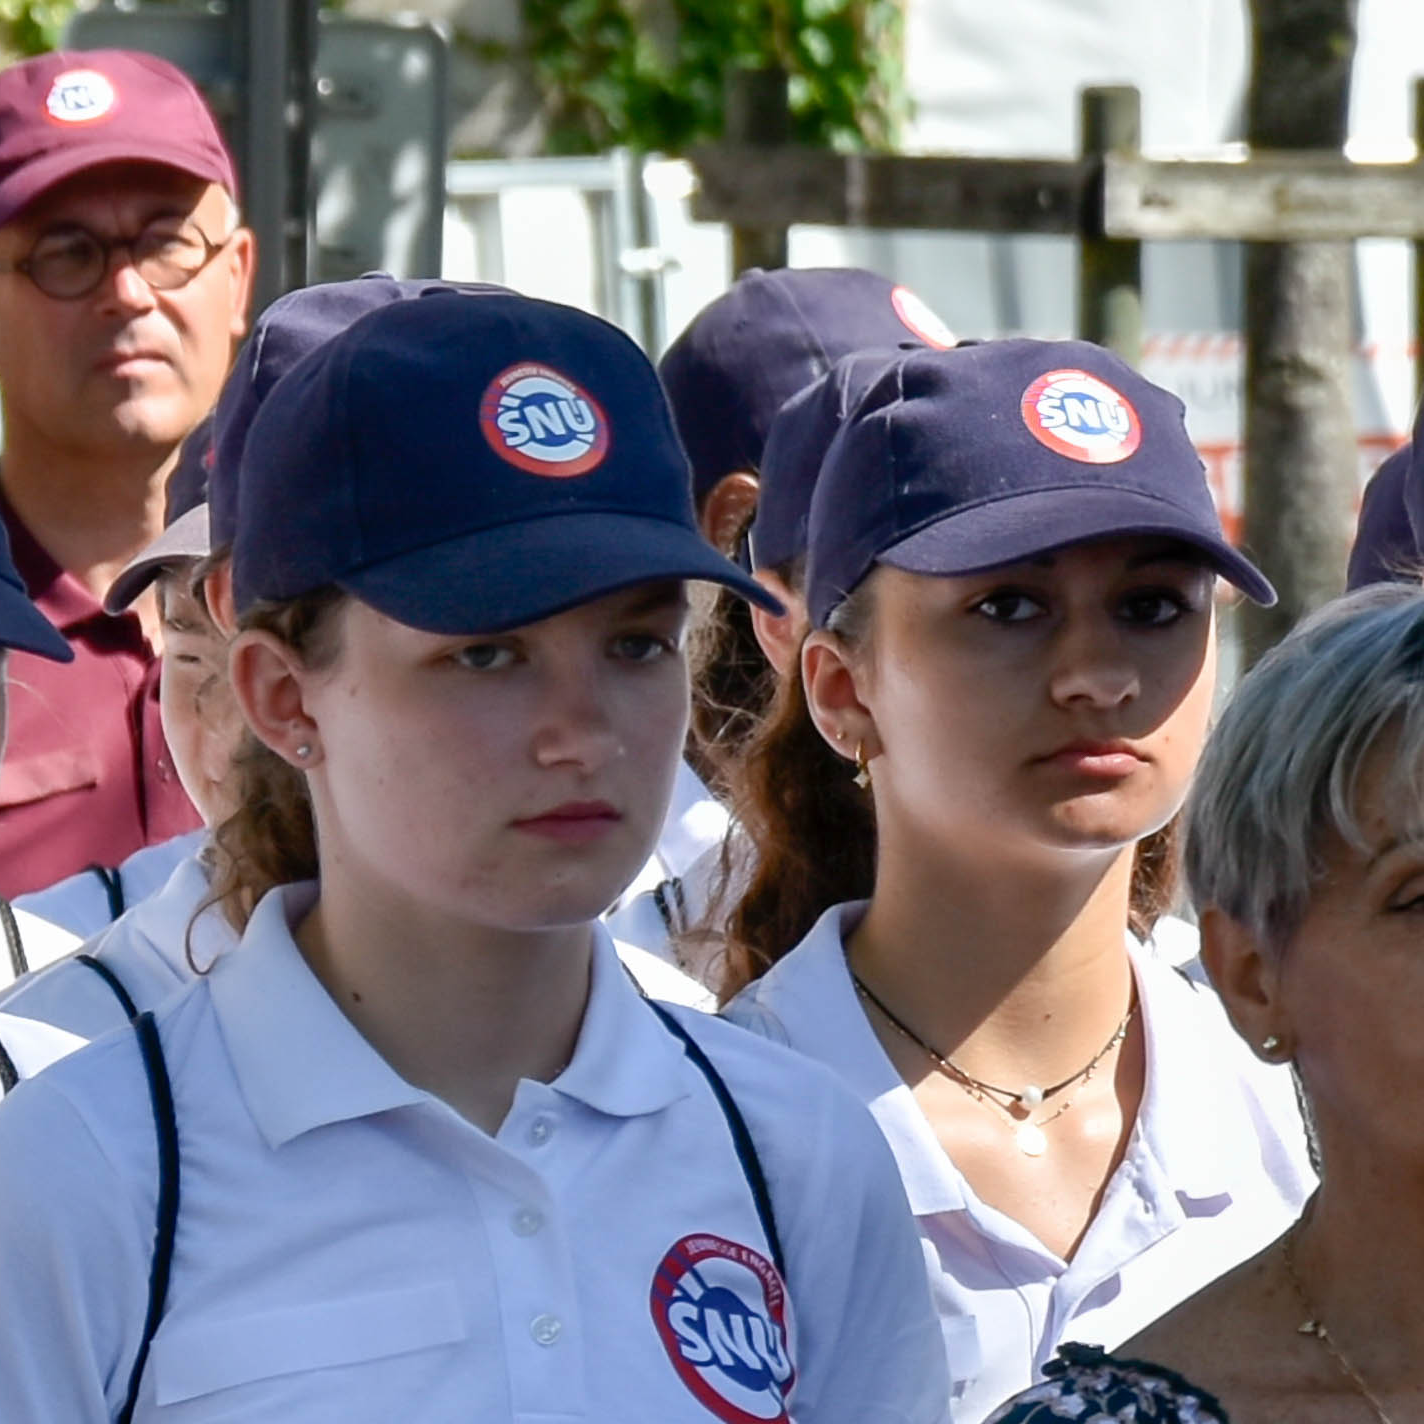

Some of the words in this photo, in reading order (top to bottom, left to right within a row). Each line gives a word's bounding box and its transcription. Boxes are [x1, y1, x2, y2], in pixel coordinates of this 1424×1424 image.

[496, 400, 596, 446] SNU
[1035, 397, 1130, 435] SNU
[668, 1301, 792, 1382] SNU
